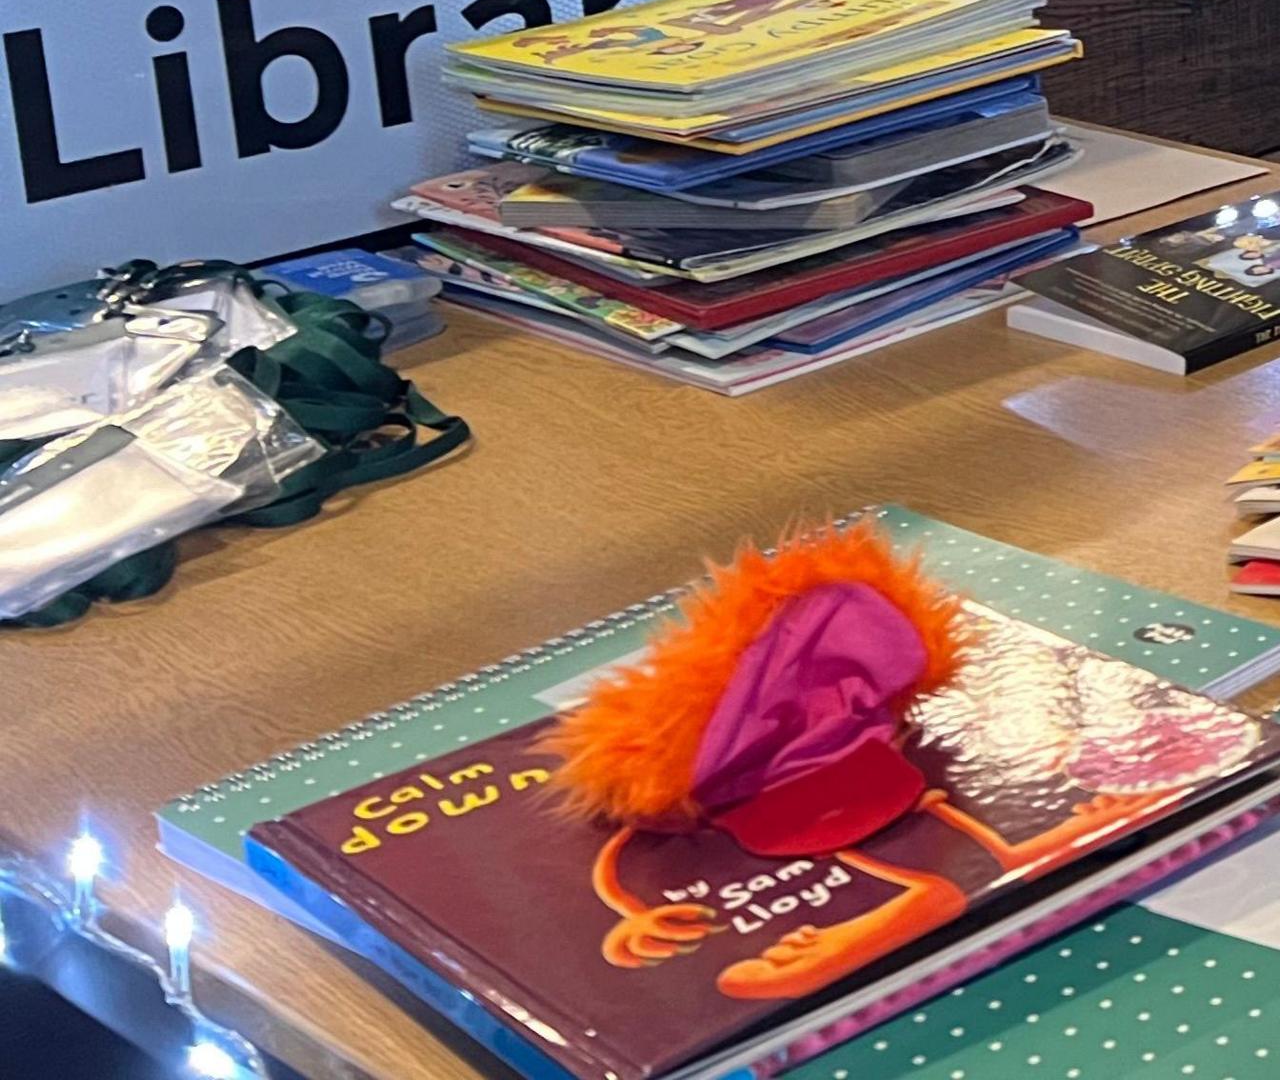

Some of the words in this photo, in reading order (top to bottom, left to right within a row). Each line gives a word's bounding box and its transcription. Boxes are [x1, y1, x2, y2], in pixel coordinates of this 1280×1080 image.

[1102, 245, 1183, 277] SPIRIT
[1136, 278, 1190, 305] THE
[340, 768, 551, 855] down
[353, 762, 495, 820] Calm
[662, 879, 711, 902] by
[718, 859, 815, 911] Sam
[731, 864, 853, 935] Lloyd
